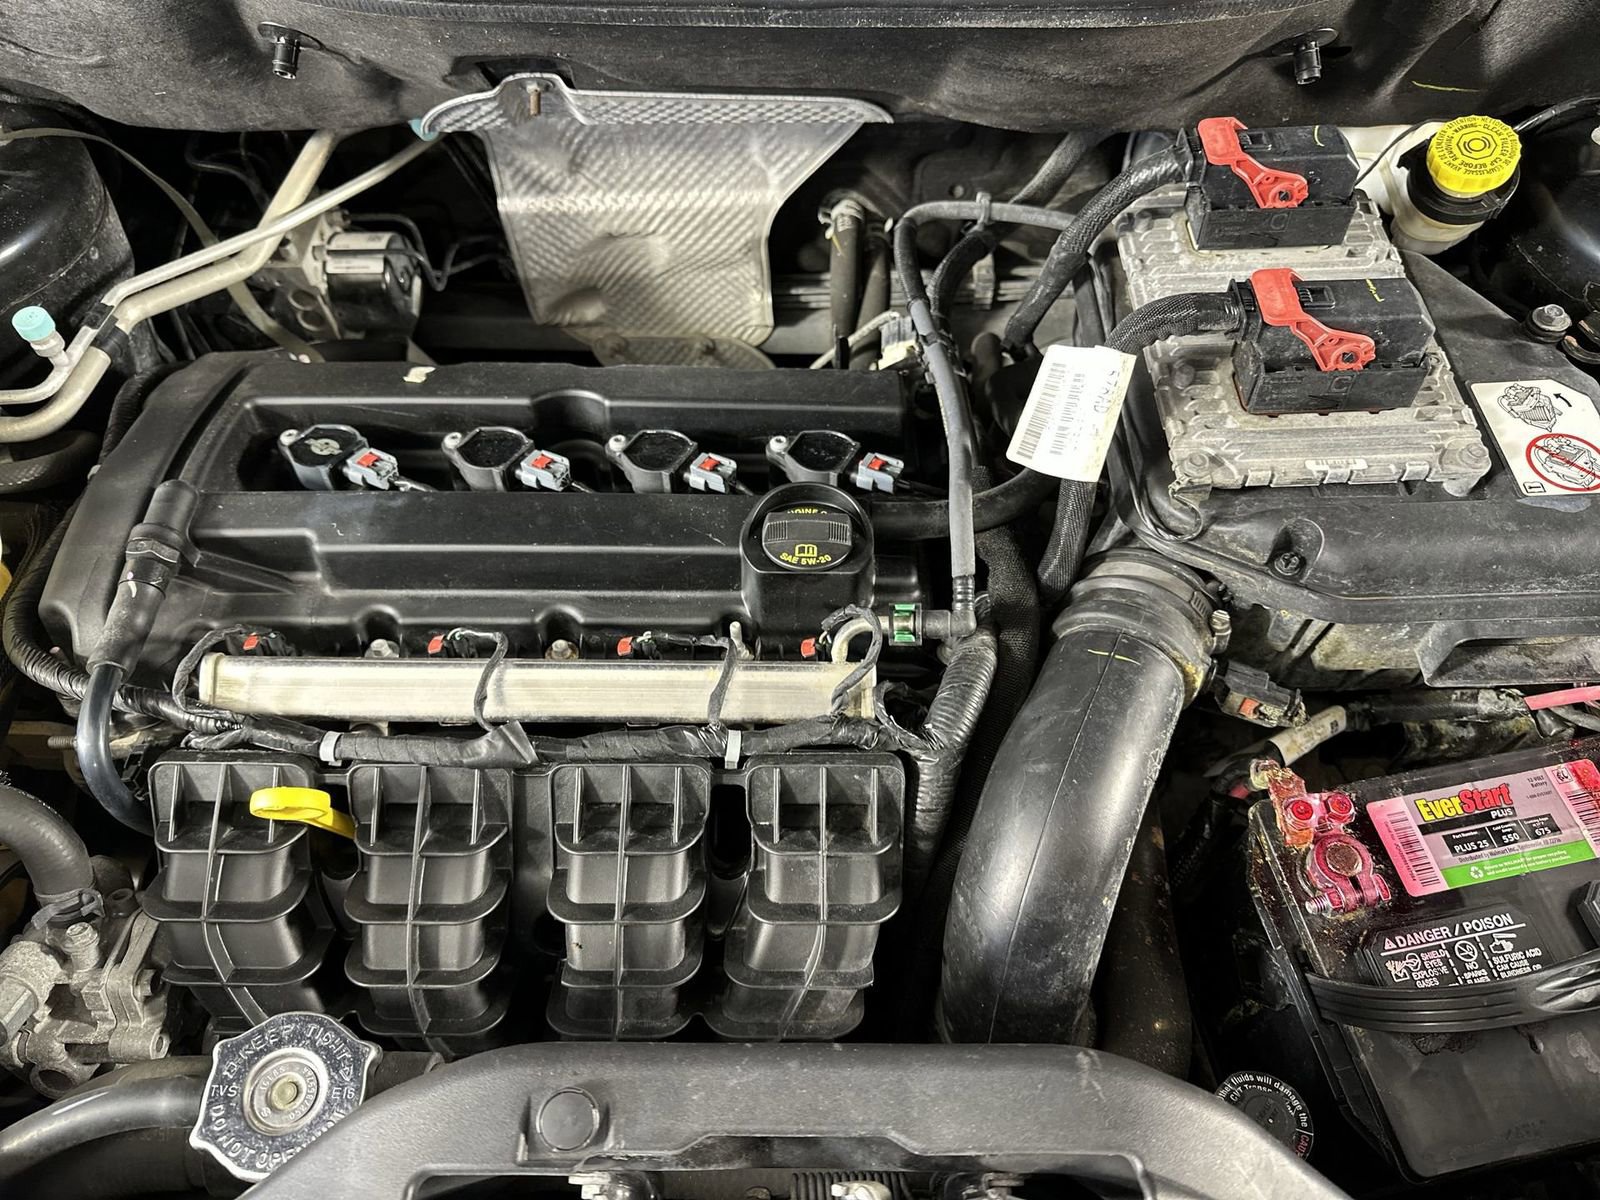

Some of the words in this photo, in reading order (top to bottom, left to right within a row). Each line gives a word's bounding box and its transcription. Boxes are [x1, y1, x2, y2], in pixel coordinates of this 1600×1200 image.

[1483, 124, 1503, 136] CLEAN
[1459, 160, 1487, 169] BEFORE
[1490, 157, 1502, 167] CAP
[780, 552, 799, 564] SAE
[800, 554, 832, 565] 5W-20
[1414, 783, 1514, 822] EverStart
[1490, 808, 1513, 819] PLUS
[1502, 832, 1520, 843] 550
[1535, 827, 1552, 836] 675
[1454, 842, 1478, 853] PLUS
[1477, 840, 1490, 849] 25
[1395, 926, 1452, 947] DANGER
[1462, 913, 1514, 933] POISON
[1420, 949, 1446, 960] SHIELD
[1492, 952, 1526, 965] SULFURIC
[1526, 948, 1542, 959] ACID
[1424, 959, 1443, 969] EYES
[1465, 961, 1479, 970] NO
[1510, 959, 1530, 968] CAUSE
[1464, 969, 1488, 980] SPARKS
[1416, 978, 1440, 988] GASES
[306, 1023, 352, 1060] TIGHT
[211, 1084, 238, 1097] TVS
[1230, 1086, 1243, 1101] CVT
[1231, 1073, 1254, 1085] fluids
[1256, 1075, 1272, 1085] will
[1274, 1082, 1302, 1110] damage
[1299, 1113, 1308, 1127] the
[210, 1104, 228, 1131] DO
[217, 1135, 256, 1163] NOT
